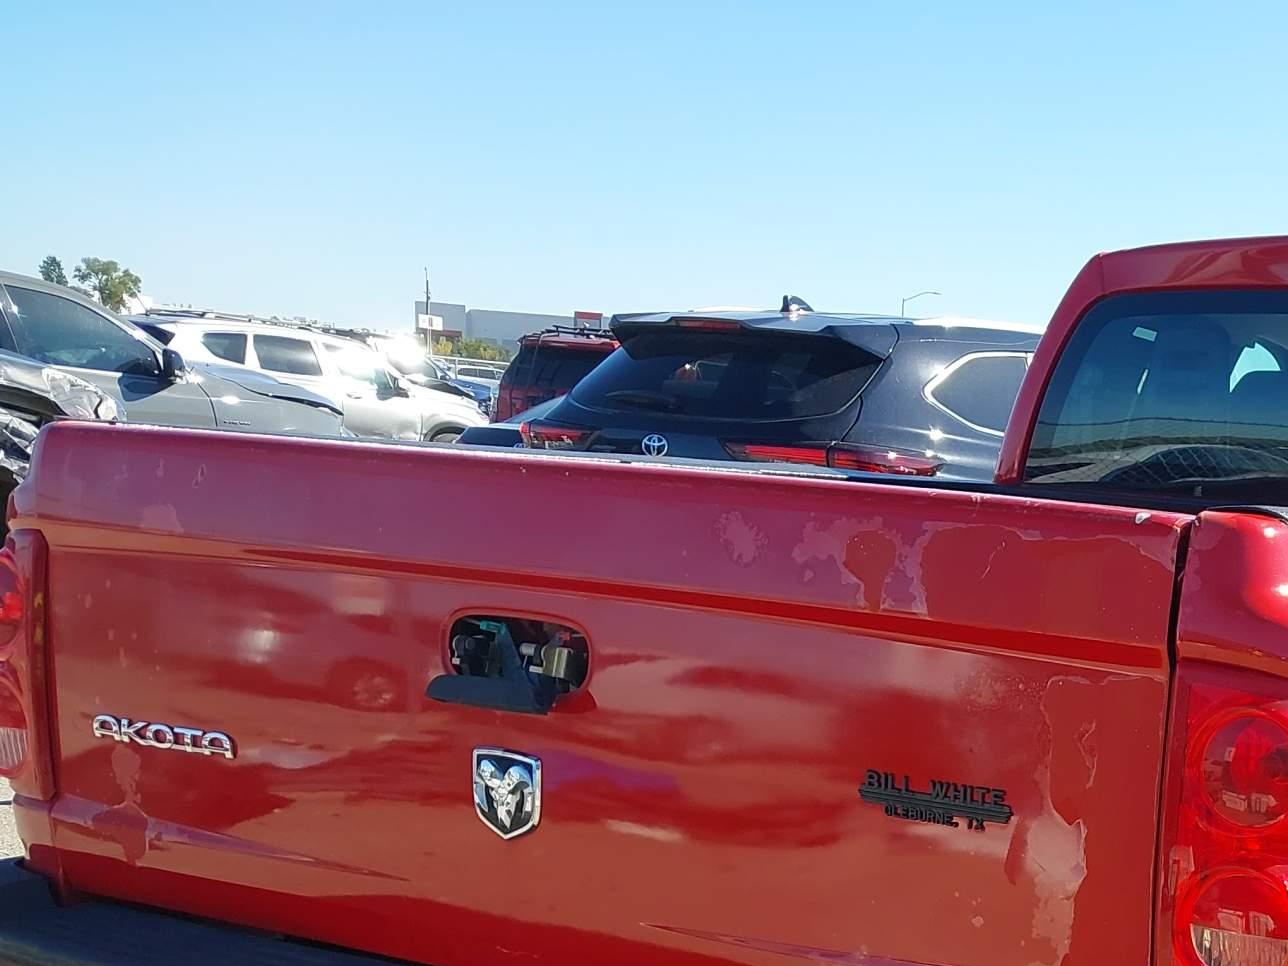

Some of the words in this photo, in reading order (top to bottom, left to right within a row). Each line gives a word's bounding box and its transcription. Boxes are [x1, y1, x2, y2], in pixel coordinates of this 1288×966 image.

[92, 714, 239, 760] AKOTA
[864, 769, 912, 794] BILL
[930, 779, 1008, 805] WHITE
[967, 816, 987, 833] TX
